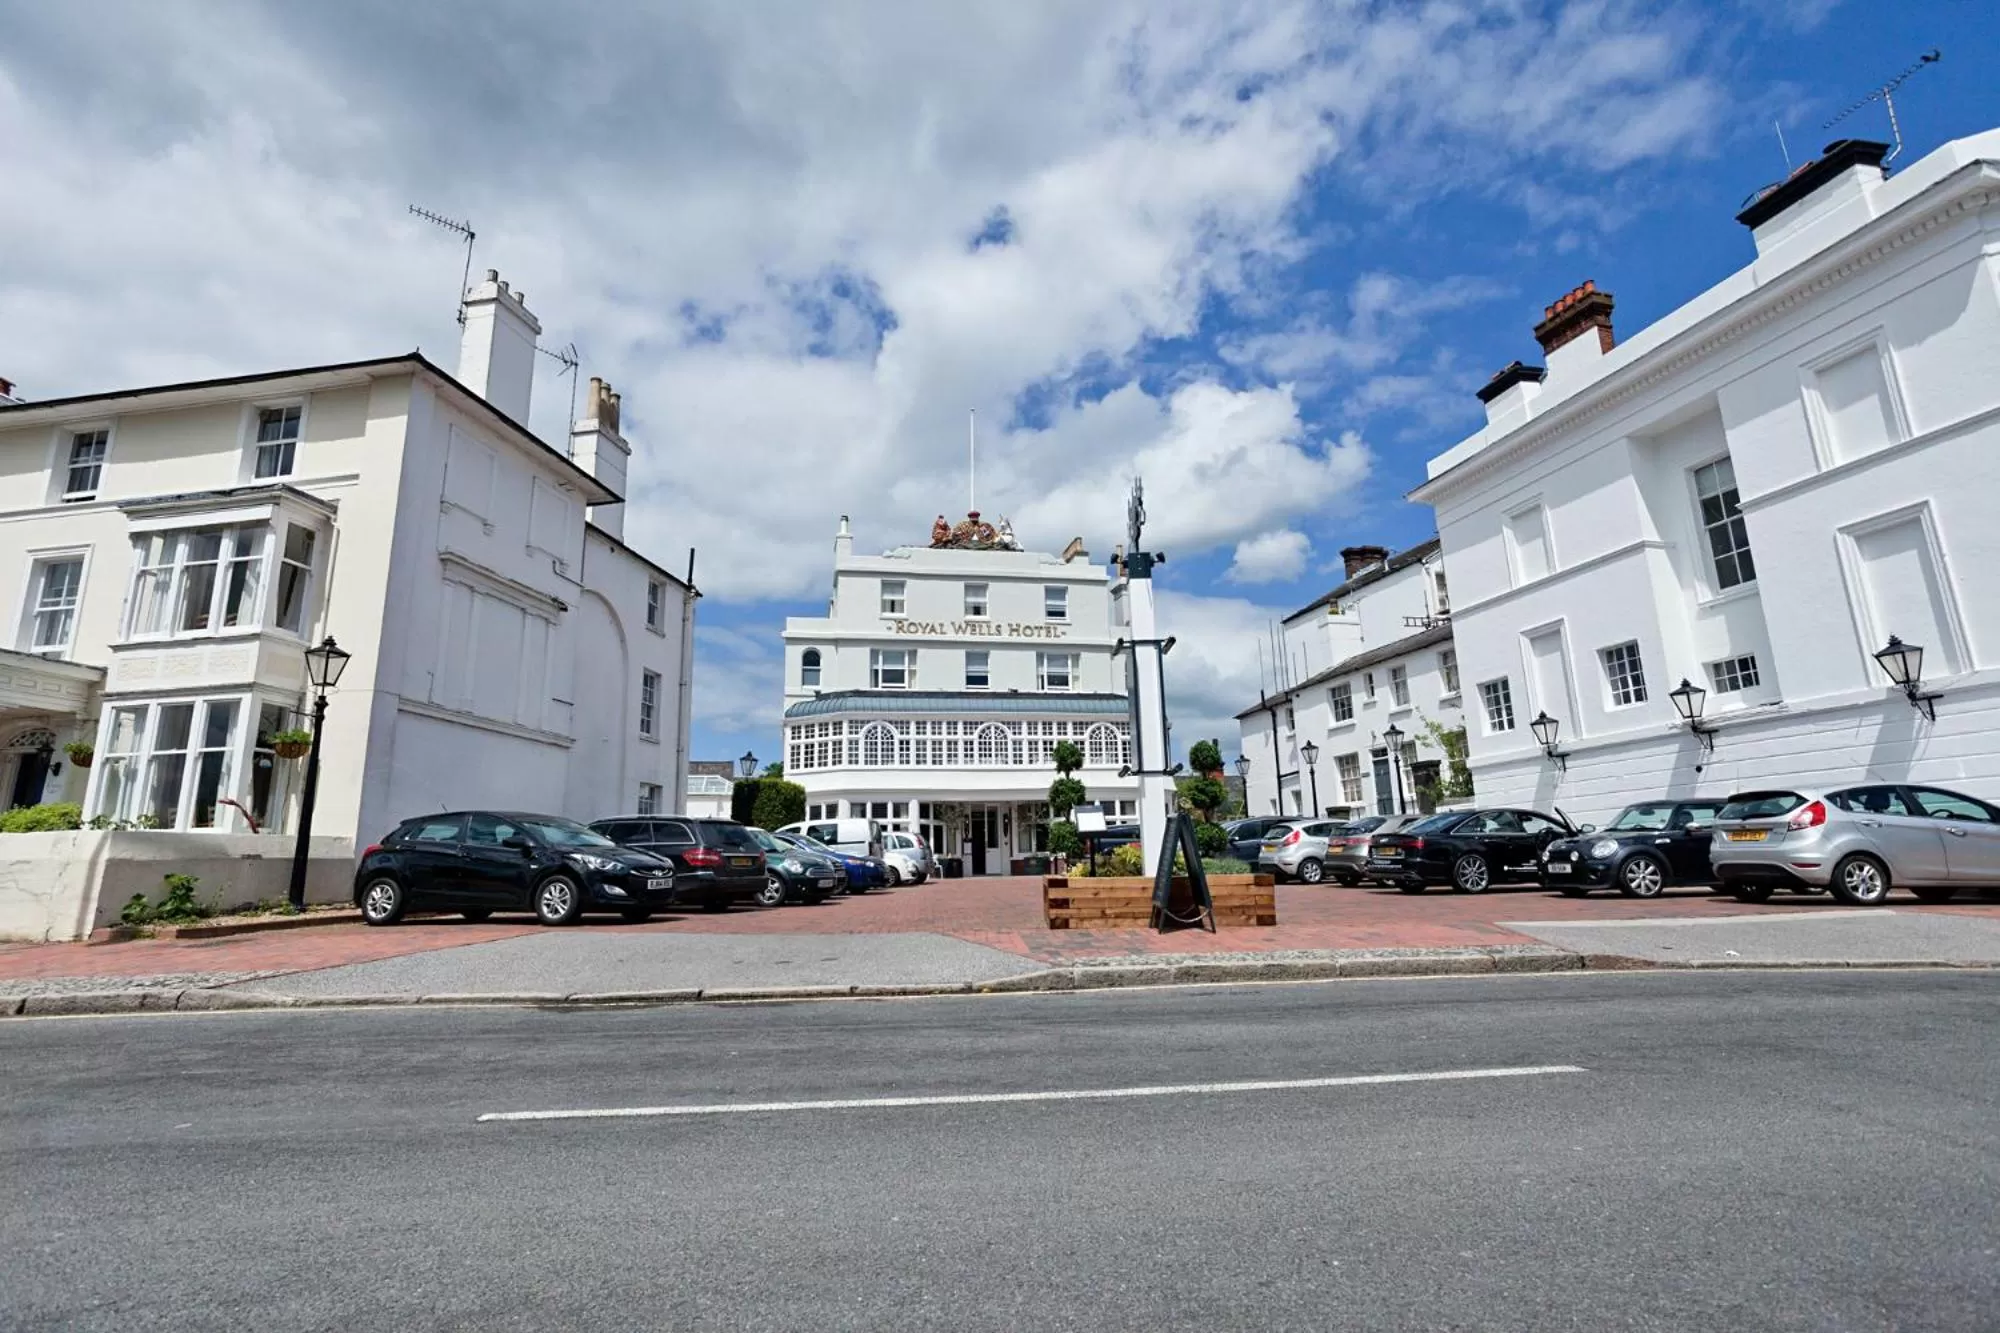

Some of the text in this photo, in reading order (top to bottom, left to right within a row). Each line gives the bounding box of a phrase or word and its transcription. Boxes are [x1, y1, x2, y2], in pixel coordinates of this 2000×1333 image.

[895, 620, 1062, 638] ROYAL WELLS HOTEL
